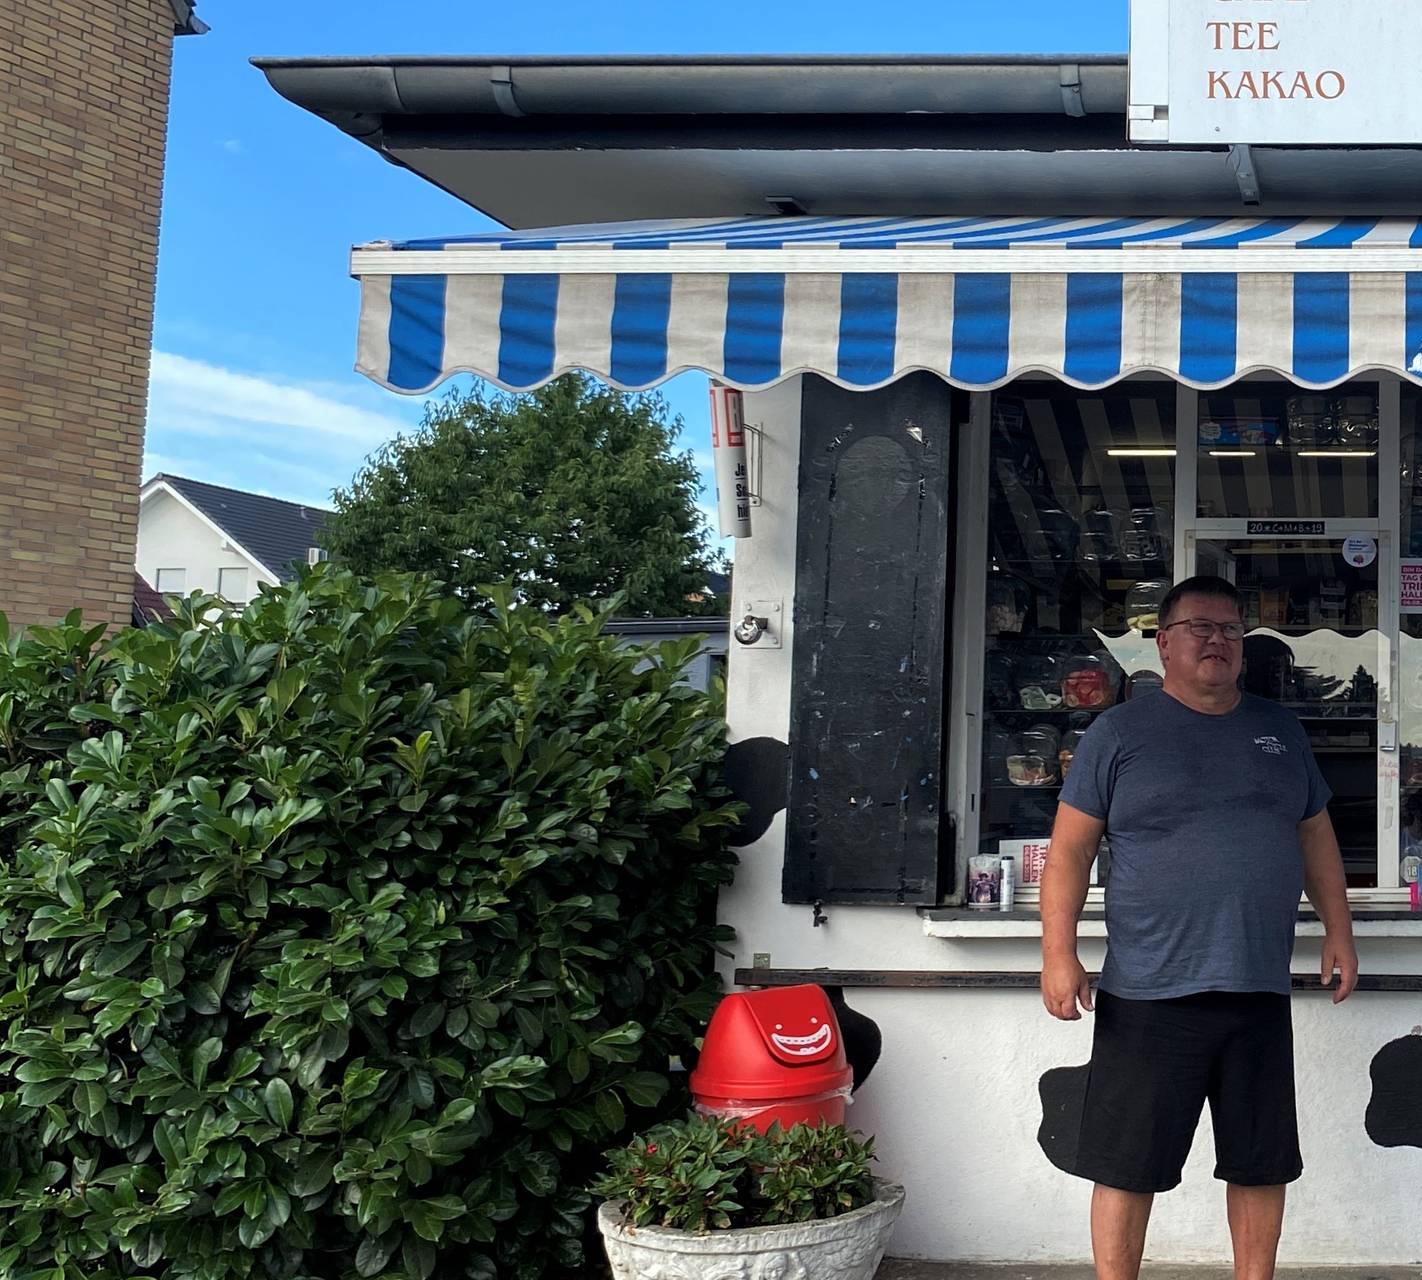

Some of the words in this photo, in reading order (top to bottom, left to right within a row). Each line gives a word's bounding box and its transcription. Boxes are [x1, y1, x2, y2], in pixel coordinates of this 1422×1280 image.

[1206, 22, 1281, 50] TEE
[1207, 70, 1346, 100] KAKAO
[1031, 844, 1039, 883] HALLEN
